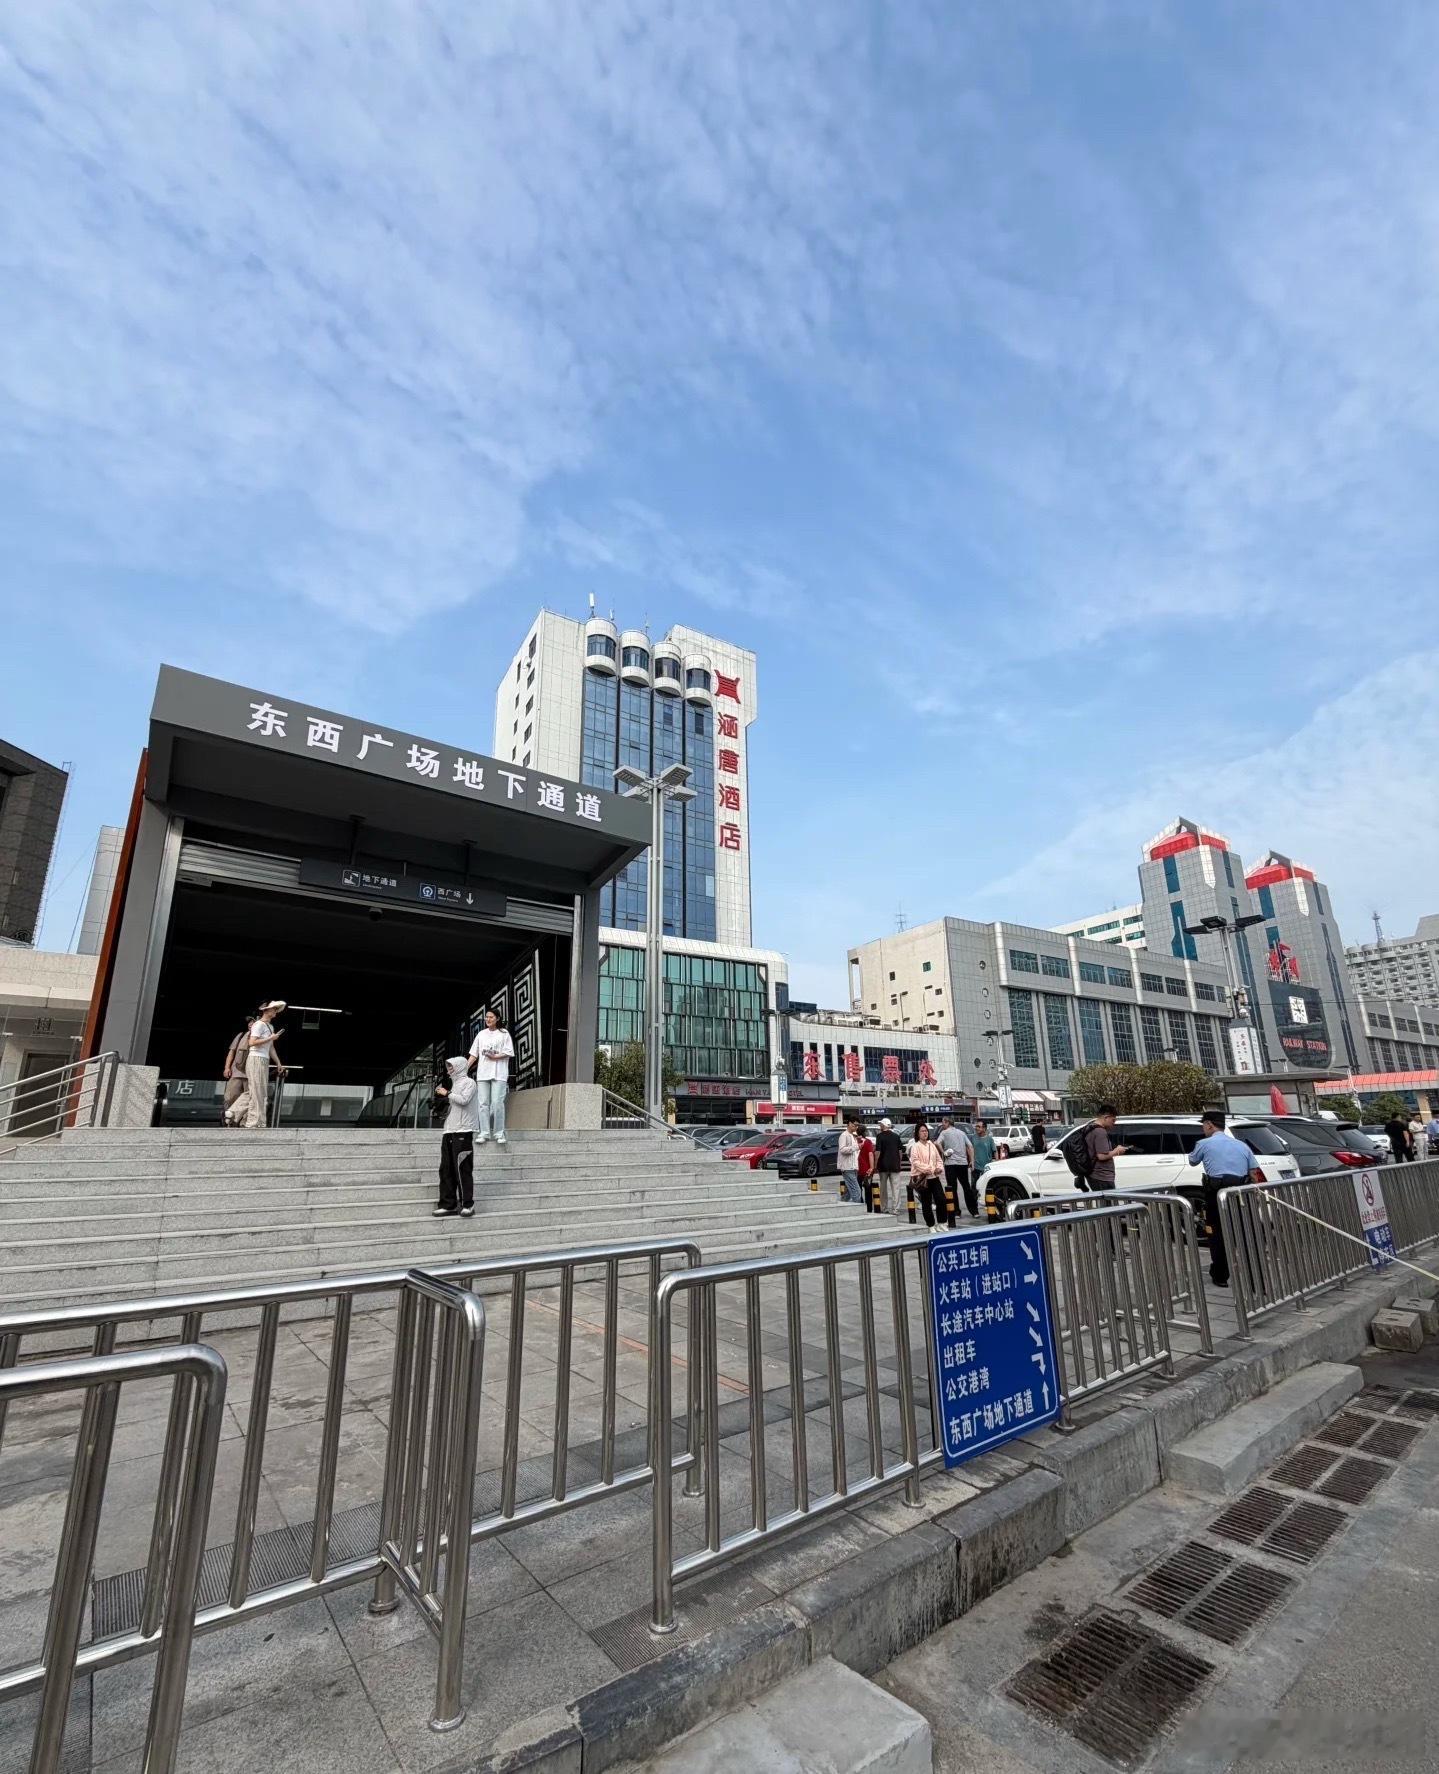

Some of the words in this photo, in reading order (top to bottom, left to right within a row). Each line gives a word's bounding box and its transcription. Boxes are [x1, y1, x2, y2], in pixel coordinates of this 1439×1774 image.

[246, 701, 602, 823] 东西广场地下通道
[937, 1245, 990, 1273] 公共卫生间
[941, 1297, 1015, 1337] 长途汽车中心站
[943, 1338, 977, 1369] 出租车
[945, 1366, 990, 1401] 公交港湾
[949, 1388, 1034, 1445] 东西广场地下通道
